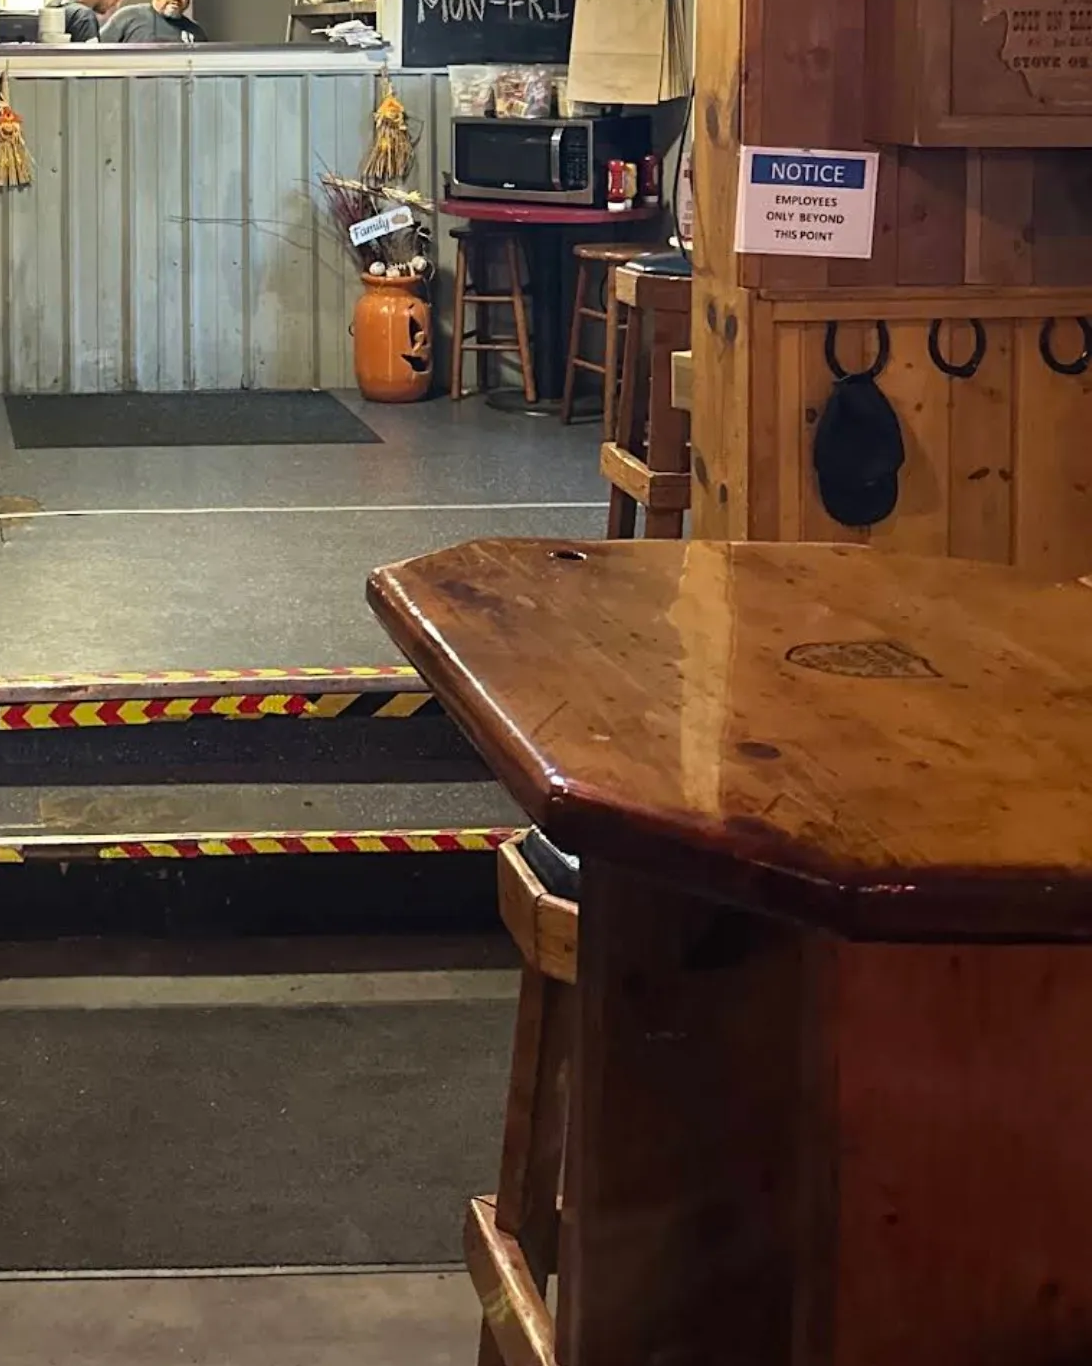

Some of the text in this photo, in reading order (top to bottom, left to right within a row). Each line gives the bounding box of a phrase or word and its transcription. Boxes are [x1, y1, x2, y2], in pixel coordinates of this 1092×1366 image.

[771, 162, 845, 183] NOTICE
[775, 195, 838, 207] EMPLOYEES
[765, 211, 845, 224] ONLY BEYOND
[353, 217, 390, 239] Family
[774, 229, 834, 241] THIS POINT
